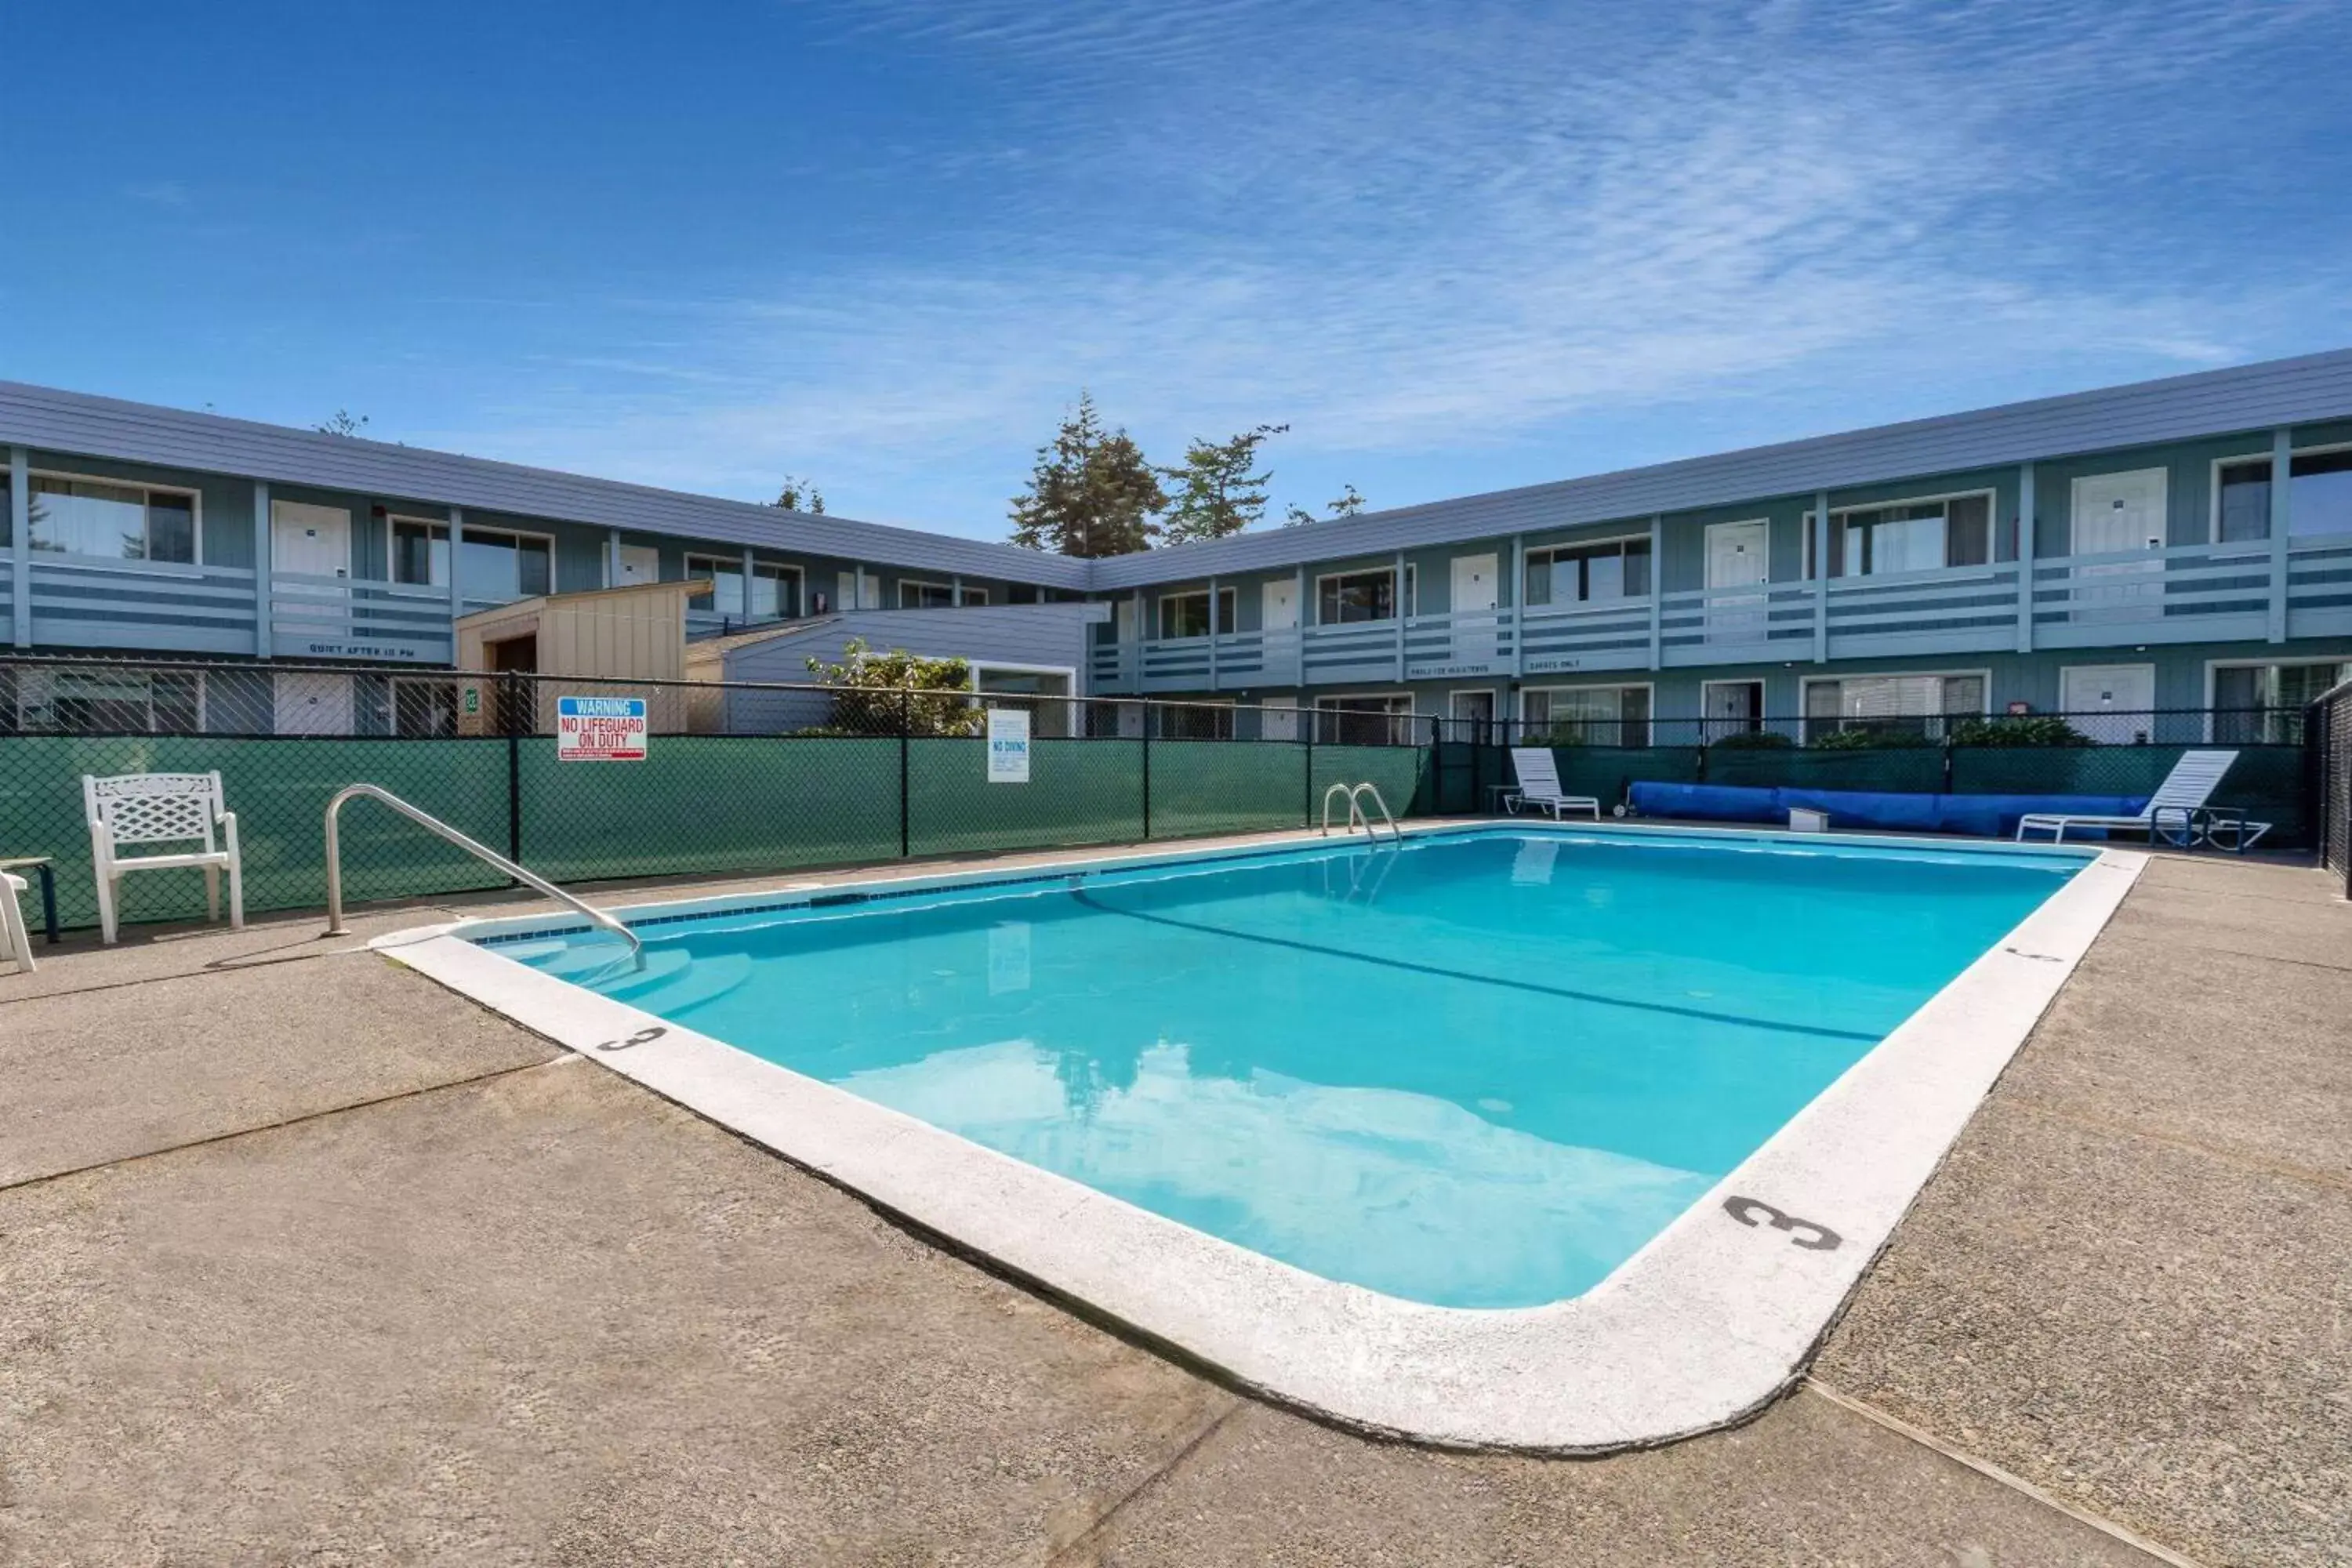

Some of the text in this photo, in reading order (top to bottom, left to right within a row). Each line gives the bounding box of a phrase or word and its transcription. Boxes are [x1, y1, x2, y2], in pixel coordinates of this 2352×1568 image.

[310, 644, 342, 653] QUIET
[347, 646, 379, 655] AFTER
[576, 699, 631, 715] WARNING
[561, 718, 643, 732] NO LIFEGUARD
[579, 734, 627, 747] ON DUTY
[993, 741, 1004, 751] NO
[597, 1026, 667, 1051] 3
[1722, 1196, 1844, 1250] 3
